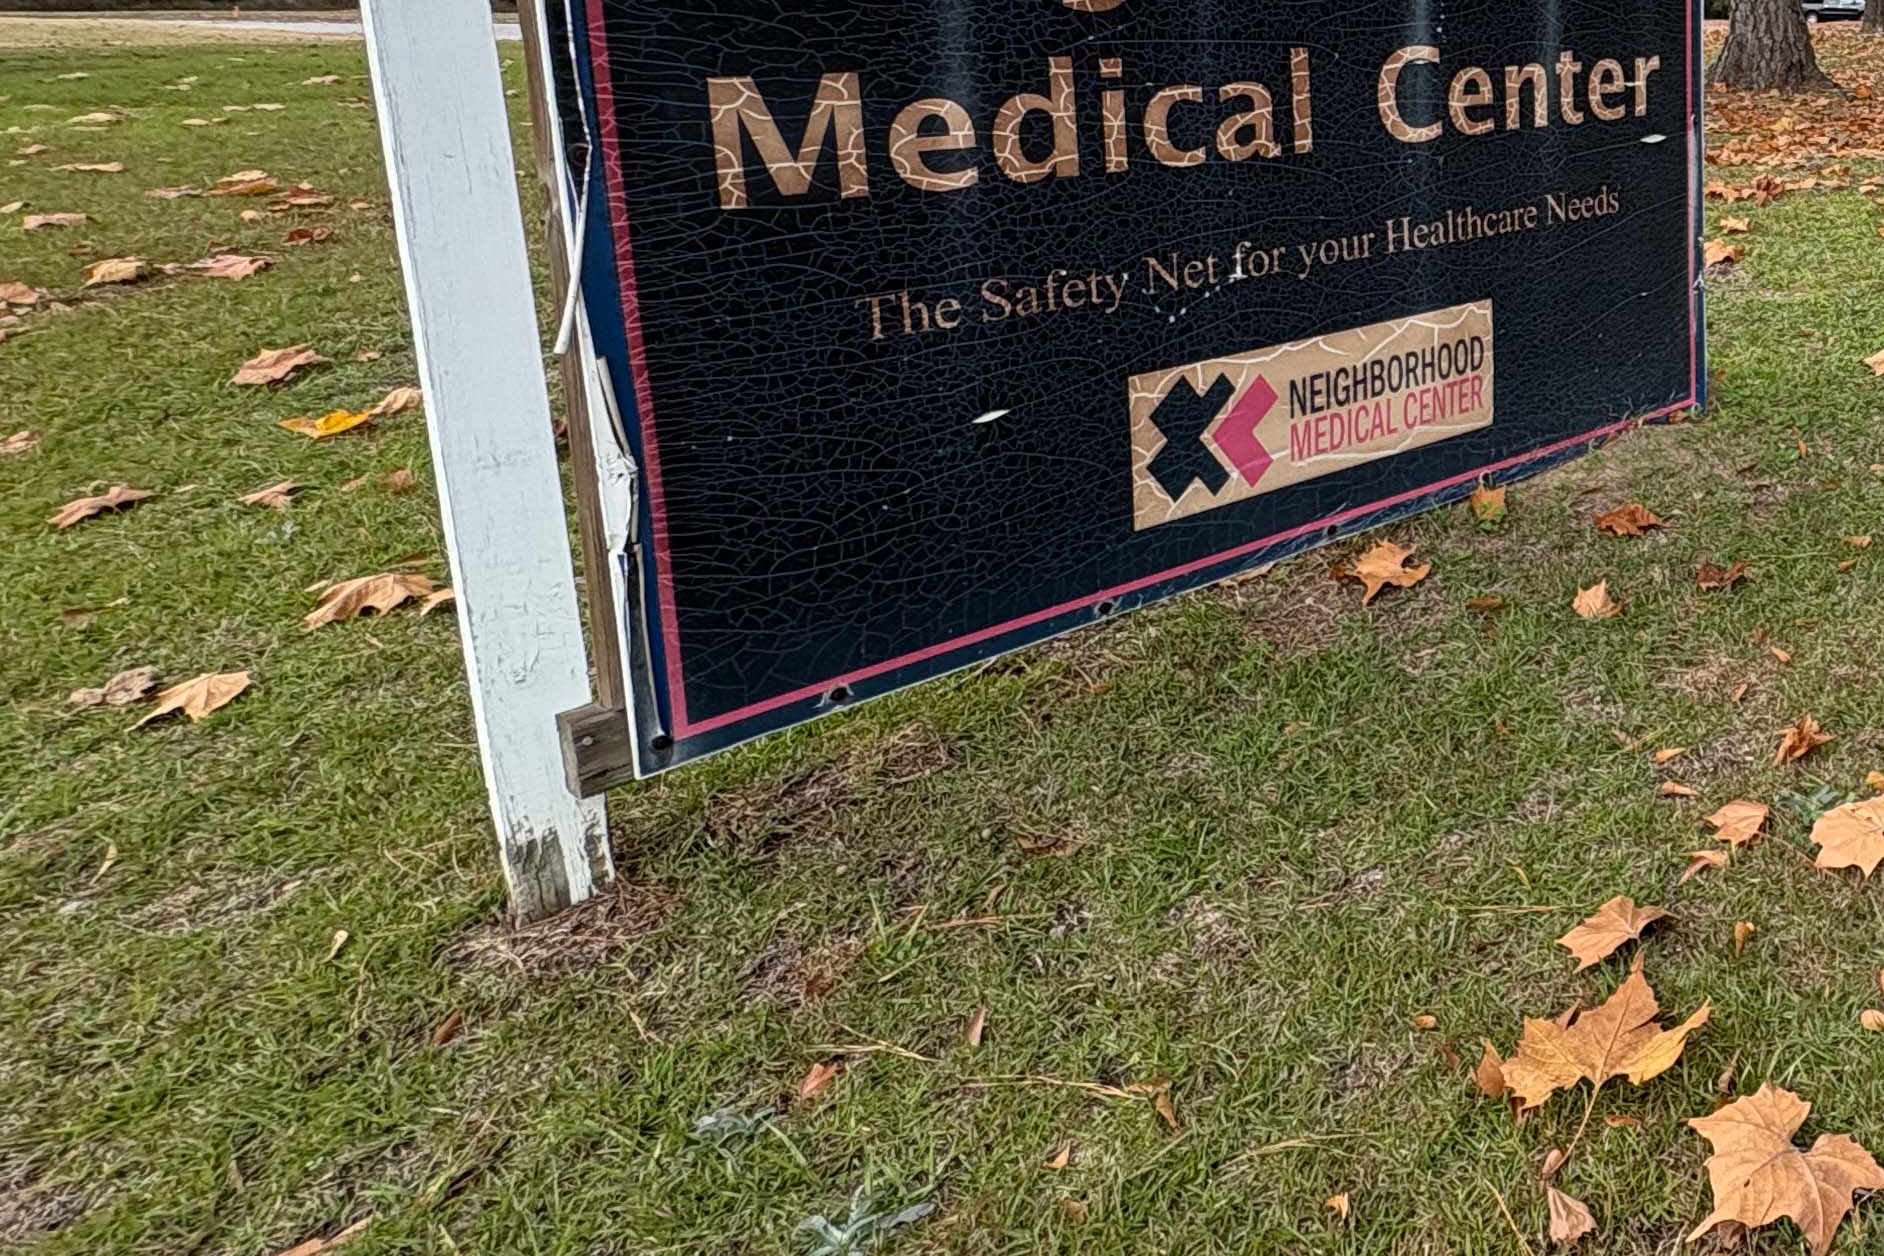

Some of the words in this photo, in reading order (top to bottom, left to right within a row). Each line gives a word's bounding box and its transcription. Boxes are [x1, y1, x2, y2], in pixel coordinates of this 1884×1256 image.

[706, 46, 1315, 210] Medical
[1377, 46, 1660, 143] Center
[855, 289, 961, 341] The
[981, 267, 1130, 324] Safety
[1143, 252, 1219, 296] Net
[1230, 239, 1286, 280] for
[1297, 228, 1377, 278] your
[1383, 201, 1539, 254] Healthcare
[1546, 185, 1621, 223] Needs
[1288, 334, 1485, 416] NEIGHBORHOOD
[1289, 395, 1399, 463] MEDICAL
[1403, 373, 1485, 429] CENTER
